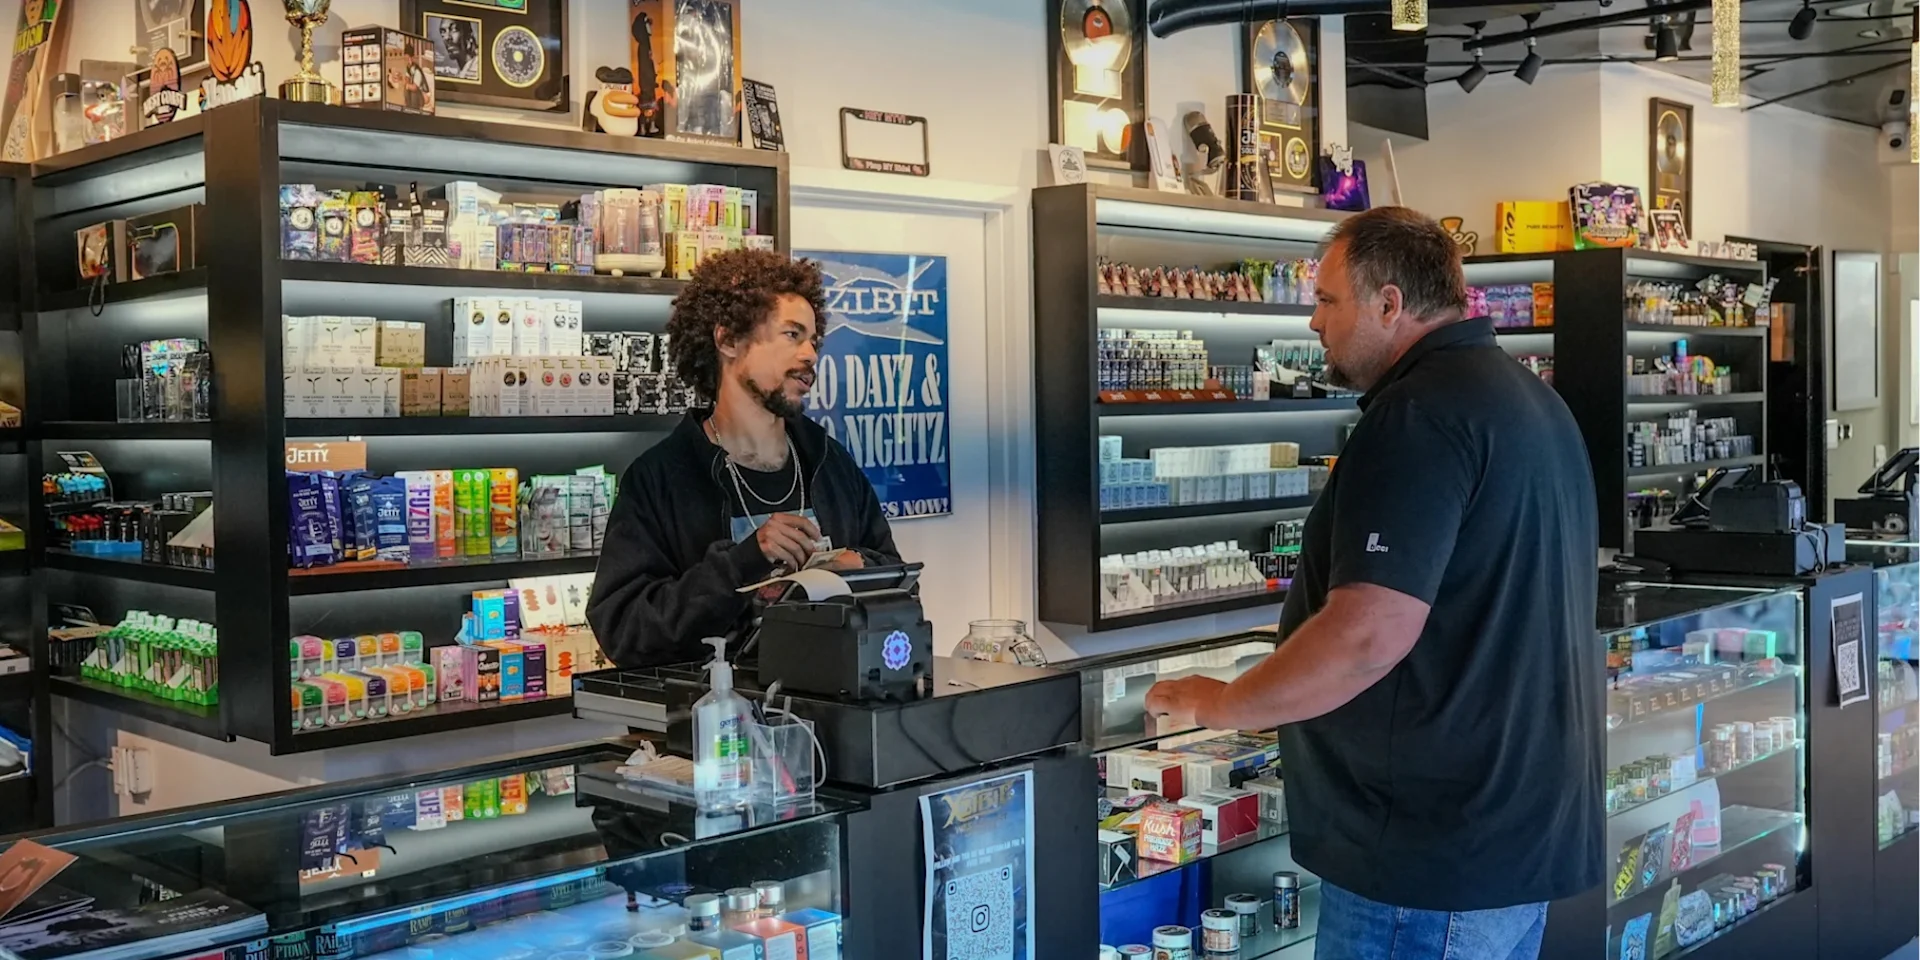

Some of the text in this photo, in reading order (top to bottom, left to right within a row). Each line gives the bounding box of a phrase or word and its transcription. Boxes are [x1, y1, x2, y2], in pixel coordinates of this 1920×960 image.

[844, 354, 914, 409] DAYZ
[921, 352, 942, 406] &
[844, 412, 946, 469] NIGHTZ
[286, 447, 329, 464] JETTY
[377, 508, 401, 517] JETTY
[409, 488, 431, 536] FUZED
[903, 496, 948, 515] NOW!
[1143, 816, 1176, 838] Kush
